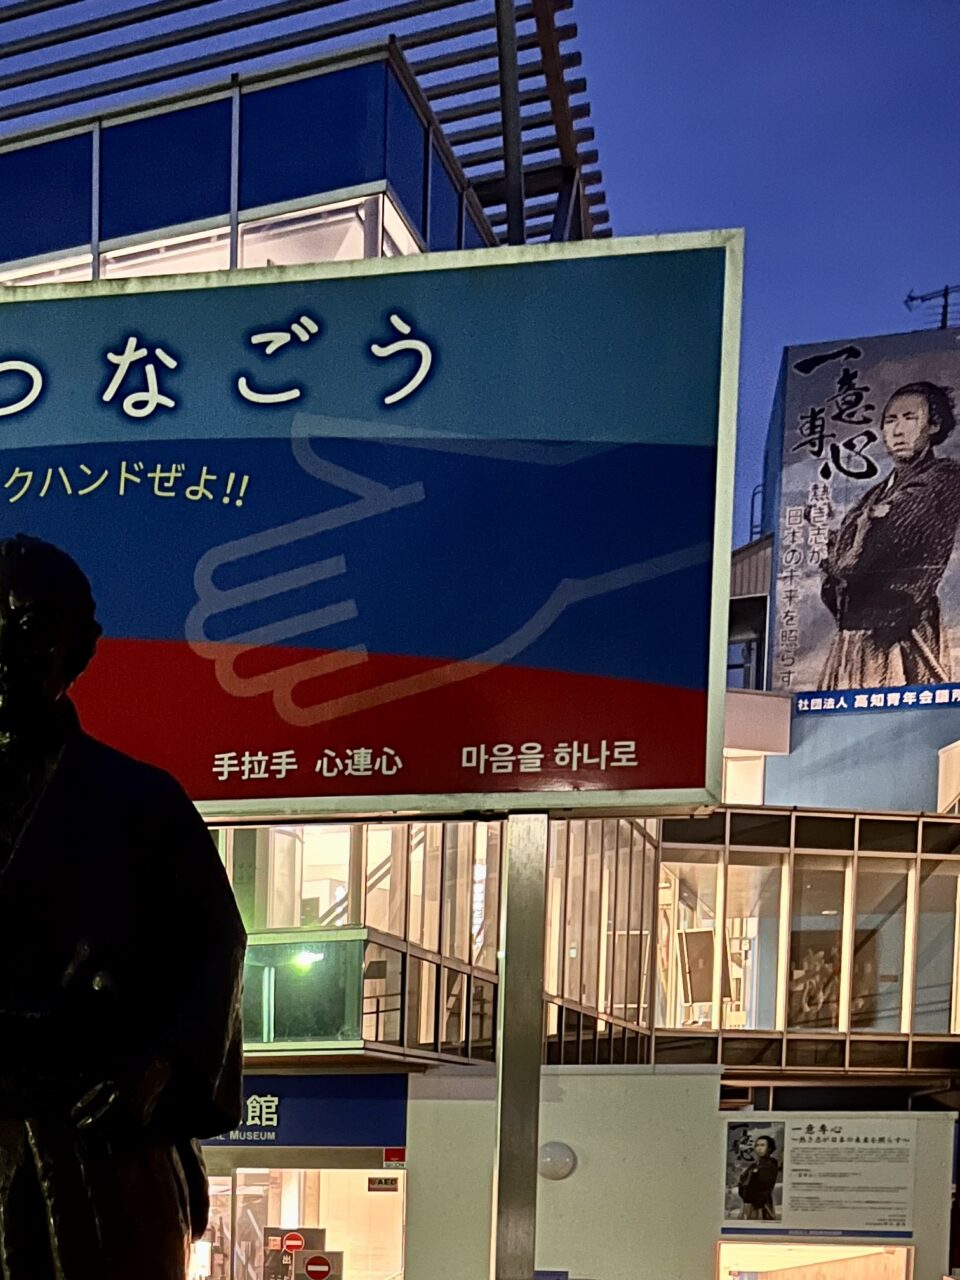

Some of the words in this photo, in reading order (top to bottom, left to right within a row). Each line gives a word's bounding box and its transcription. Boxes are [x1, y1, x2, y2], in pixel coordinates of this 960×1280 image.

[212, 749, 298, 780] 手拉手
[314, 746, 403, 778] 心連心
[460, 742, 545, 775] 마음을
[553, 740, 639, 771] 하나로
